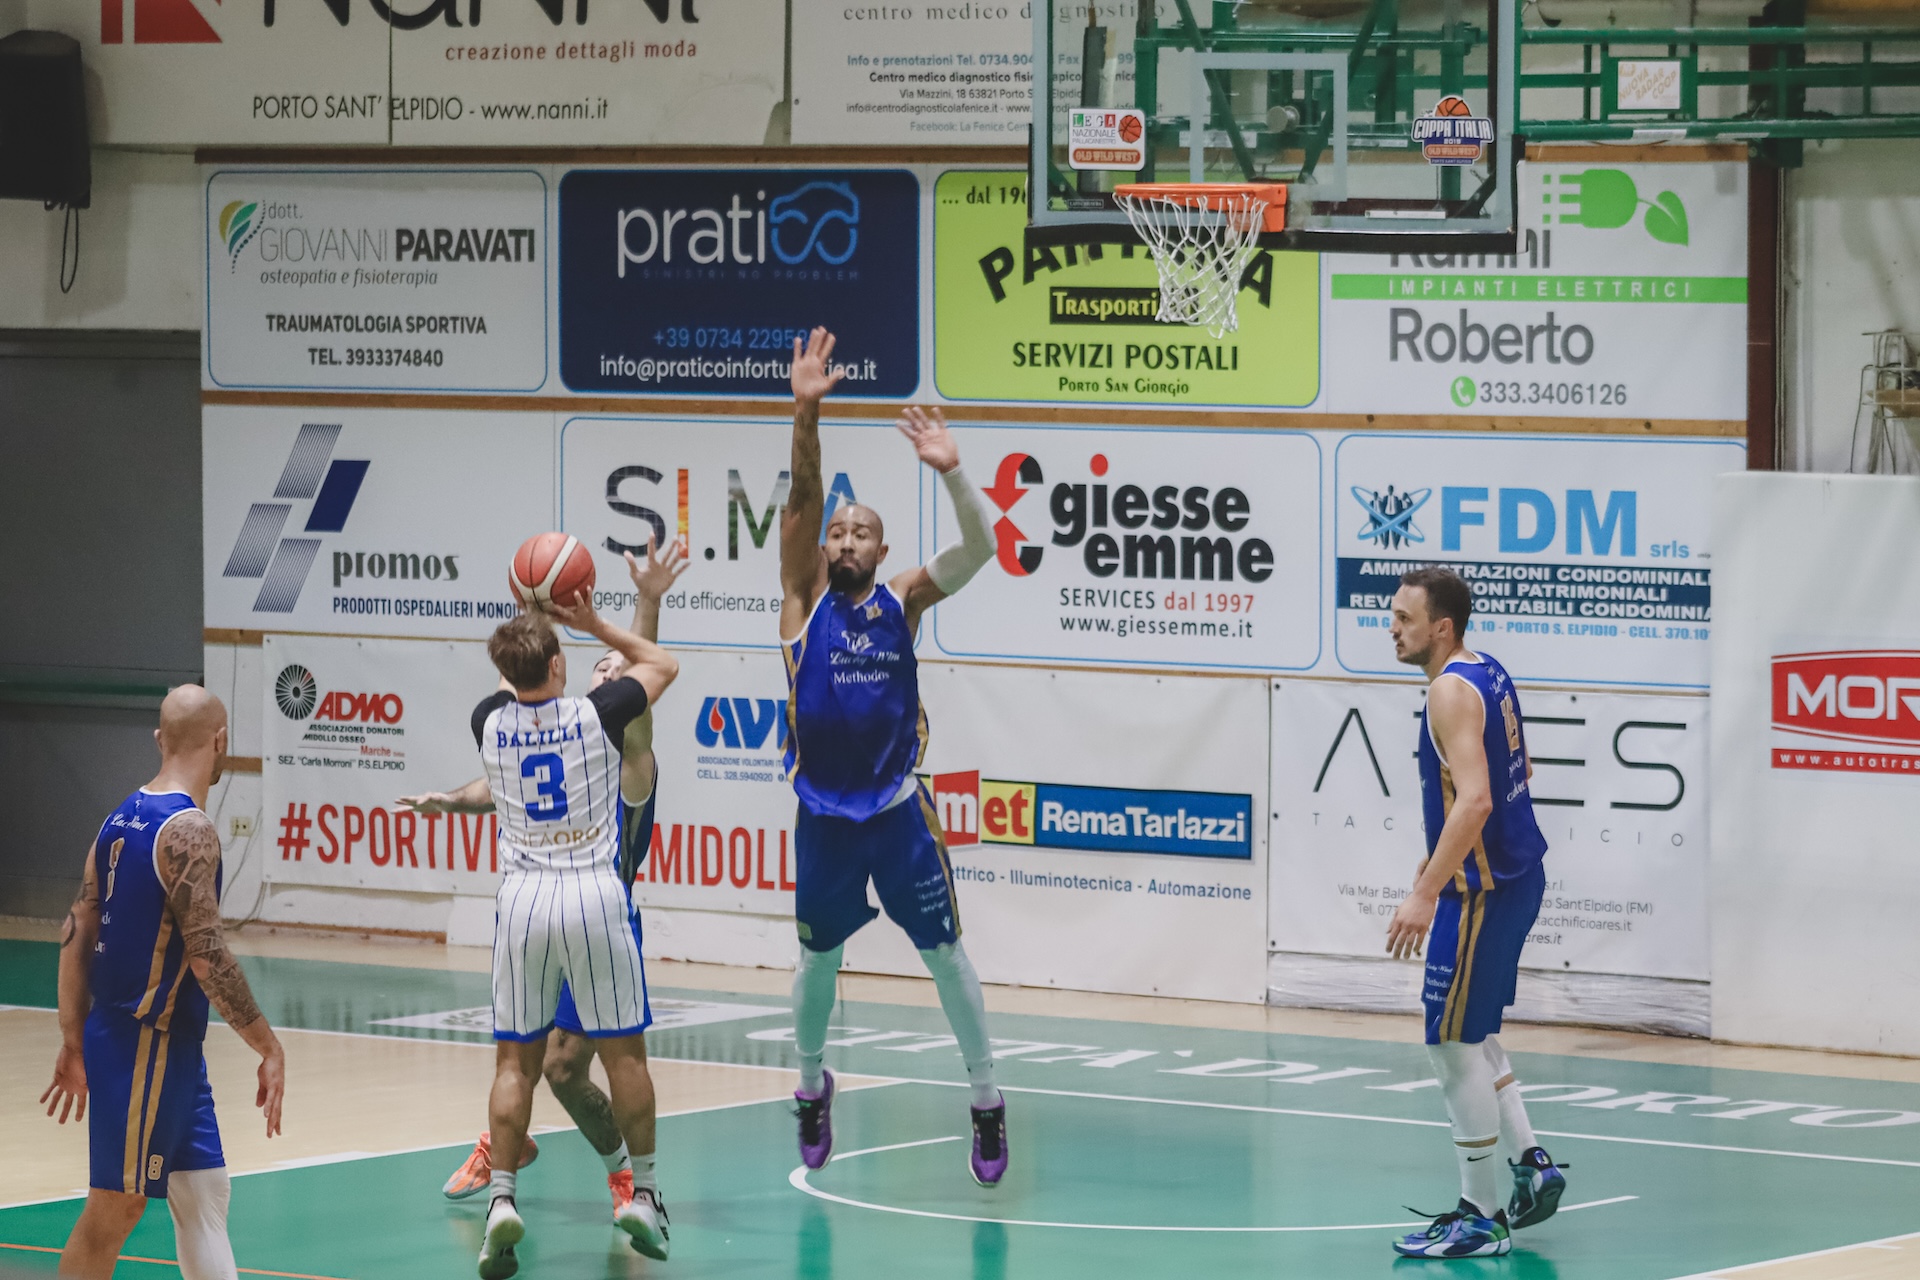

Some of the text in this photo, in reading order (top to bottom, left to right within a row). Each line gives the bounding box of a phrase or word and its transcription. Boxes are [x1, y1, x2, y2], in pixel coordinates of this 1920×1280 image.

[843, 6, 912, 20] centro
[927, 3, 1008, 20] medico
[445, 41, 697, 63] creazione dettagli moda
[847, 55, 870, 66] Info
[872, 57, 880, 66] e
[882, 55, 953, 68] prenotazioni
[956, 55, 975, 66] Tel.
[869, 72, 905, 83] Centro
[908, 72, 946, 83] medico
[949, 72, 1011, 85] diagnostico
[899, 89, 914, 99] Via
[917, 89, 953, 100] Mazzini,
[956, 89, 966, 99] 18
[968, 89, 997, 99] 63821
[1000, 89, 1025, 99] Porto
[253, 95, 609, 121] PORTO SANT' ELPIDIO www.nanni.it
[846, 103, 998, 115] info@centrodiagnosticolafenice.it
[960, 122, 971, 132] La
[973, 122, 1004, 132] Fenice
[1072, 129, 1116, 138] NAZIONALE
[1414, 120, 1491, 140] COPPA ITALIA
[1075, 151, 1138, 162] OLD WILD WEST
[966, 186, 992, 205] dal
[268, 202, 303, 219] dott.
[259, 227, 535, 263] GIOVANNI PARAVATI
[260, 267, 438, 288] osteopatia e fisioterapia
[774, 270, 858, 281] PROBLEM
[1388, 279, 1691, 299] IMPIANTI ELETTRICI
[265, 314, 487, 334] TRAUMATOLOGIA SPORTIVA
[653, 328, 690, 348] +39
[695, 328, 743, 348] 0734
[1388, 306, 1595, 366] Roberto
[308, 348, 443, 367] TEL. 3933374840
[1012, 342, 1238, 371] SERVIZI POSTALI
[1479, 382, 1627, 406] 333.3406126
[1050, 453, 1250, 547] giesse
[1441, 486, 1690, 558] FDM srls
[1083, 532, 1274, 583] emme
[332, 551, 459, 588] promos
[666, 591, 686, 609] ed
[690, 592, 766, 612] efficienza
[1060, 588, 1254, 613] SERVICES dal 1997
[1516, 583, 1667, 602] PATRIMONIALI
[333, 596, 521, 620] PRODOTTI OSPEDALIERI MONOU
[1470, 598, 1573, 616] ONTABILI
[1060, 616, 1253, 638] www.giessemme.it
[1357, 616, 1378, 628] VIA
[1480, 620, 1495, 632] 10
[1506, 621, 1549, 634] PORTO
[1553, 622, 1565, 635] S.
[1567, 623, 1618, 637] ELPIDIO
[1629, 626, 1661, 639] CELL.
[834, 669, 890, 686] Methodos
[314, 691, 404, 724] ADMO
[302, 734, 365, 744] MIDOLLO OSSEO
[309, 724, 404, 736] ASSOCIAZIONE DONATORI
[496, 723, 582, 748] BALILLI
[360, 745, 391, 757] Marche
[278, 755, 295, 765] SEZ.
[358, 759, 405, 771] P.S.ELPIDIO
[697, 756, 740, 766] ASSOCIAZIONE
[741, 758, 774, 767] VOLONTARI
[697, 769, 773, 782] CELL. 328.5940920
[521, 752, 569, 822] 3
[1041, 801, 1245, 843] RemaTarlazzi
[1009, 869, 1132, 893] Illuminotecnica
[1147, 879, 1252, 900] Automazione
[1338, 884, 1355, 896] Via
[1357, 885, 1379, 898] Mar
[1555, 897, 1623, 913] Sant'Elpidio
[1625, 901, 1653, 916] (FM)
[1357, 902, 1374, 915] Tel.
[147, 1154, 164, 1181] 8
